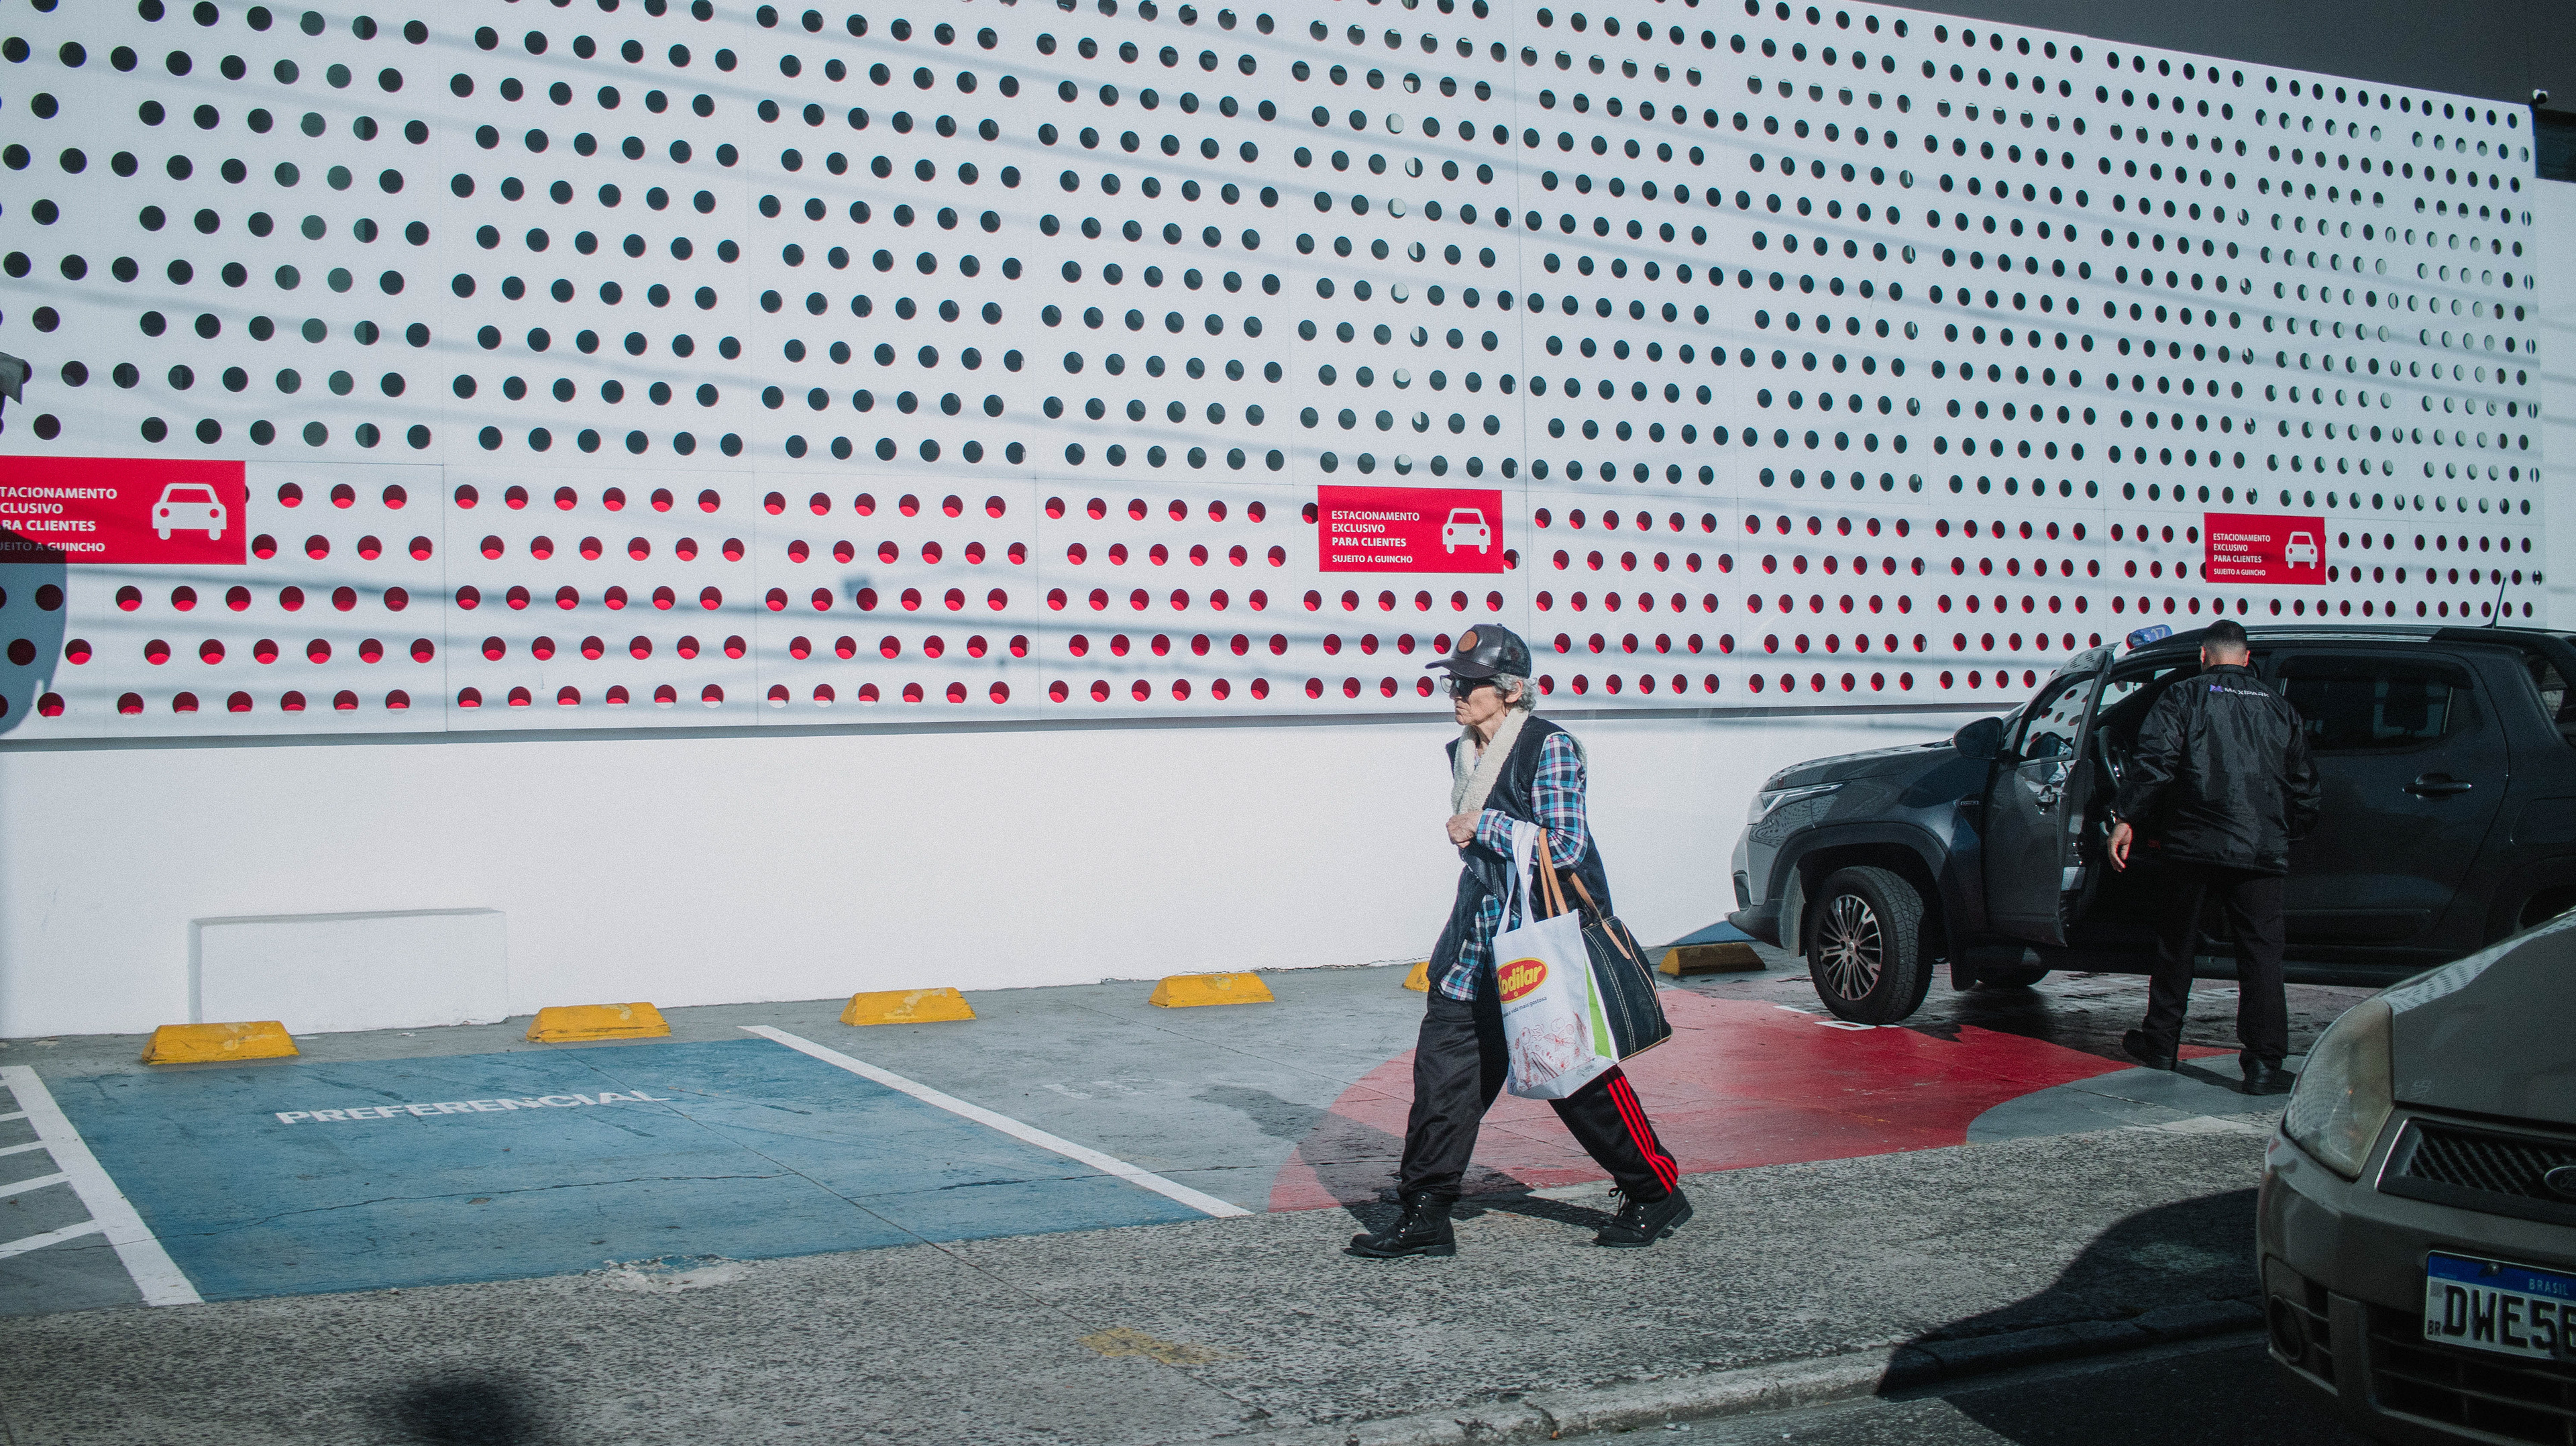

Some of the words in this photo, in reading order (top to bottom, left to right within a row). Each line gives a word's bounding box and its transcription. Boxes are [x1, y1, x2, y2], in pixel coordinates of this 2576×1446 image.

[0, 486, 117, 499] TACIONAMENTO
[0, 503, 64, 515] CLUSIVO
[1331, 510, 1420, 521] ESTACIONAMENTO
[25, 519, 97, 531] CLIENTES
[1332, 523, 1386, 533] EXCLUSIVO
[1332, 537, 1359, 546] PARA
[1360, 537, 1407, 548] CLIENTES
[2213, 533, 2271, 542] ESTACIONAMENTO
[36, 541, 44, 551] A
[47, 541, 106, 552] GUINCHO
[2213, 543, 2248, 552] EXCLUSIVO
[1332, 554, 1366, 563] SUJEITO
[1366, 555, 1373, 563] A
[1375, 555, 1413, 564] GUINCHO
[2213, 554, 2231, 562] PARA
[2232, 555, 2262, 563] CLIENTES
[2224, 688, 2269, 697] MAXIPARK
[274, 1089, 672, 1125] PREFERENCIAL
[2528, 1278, 2569, 1296] BRASIL
[2426, 1319, 2442, 1337] BR
